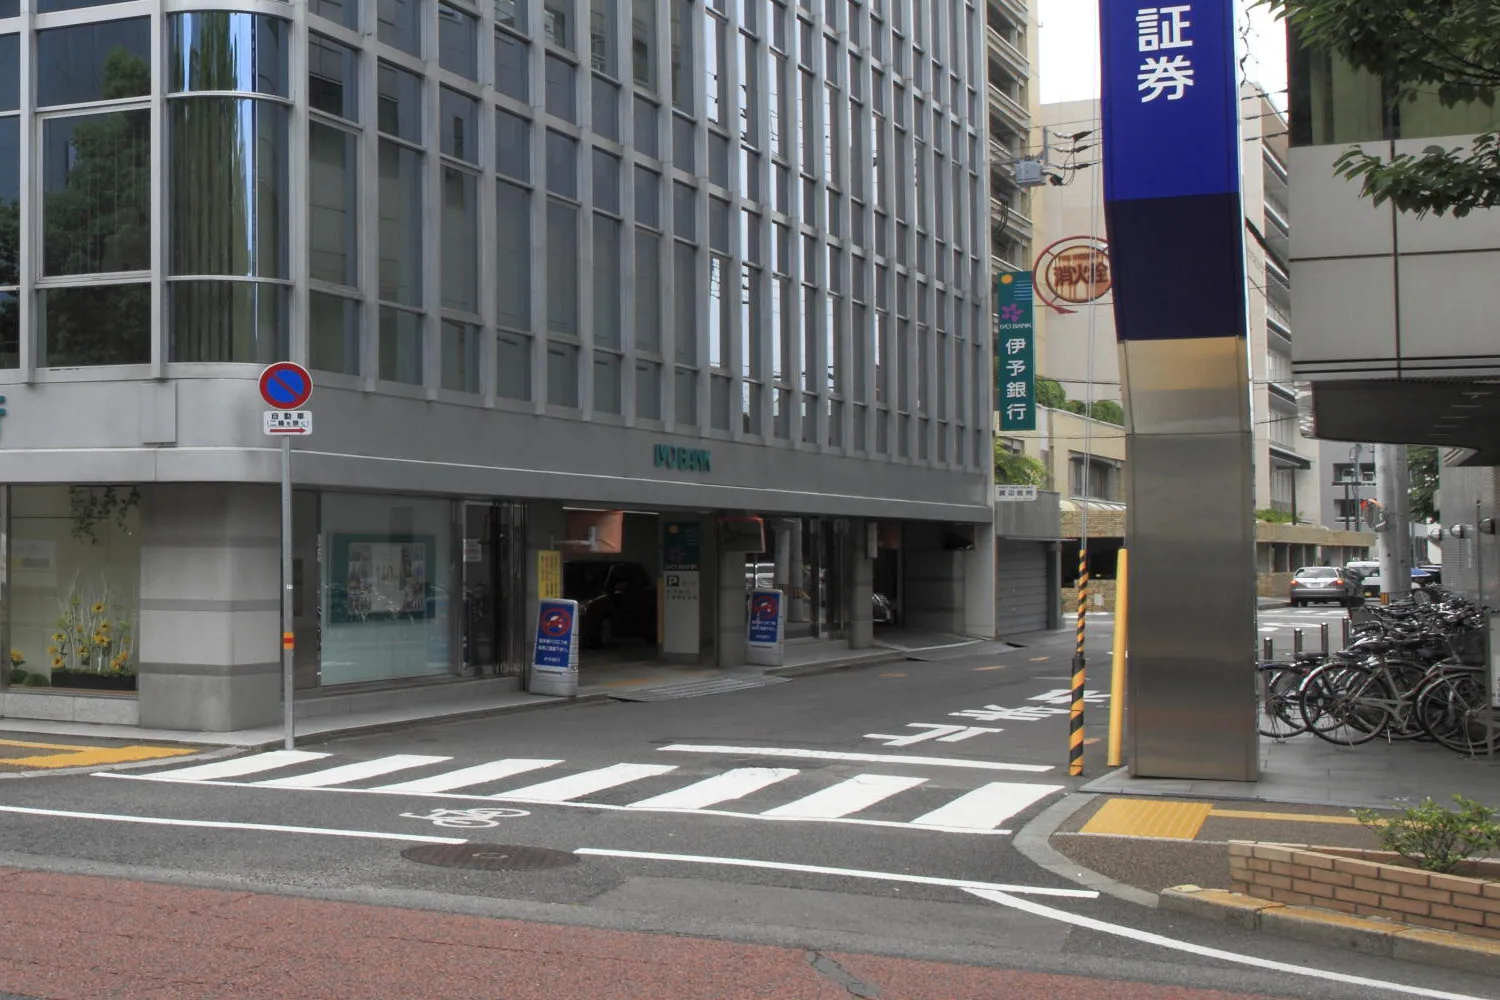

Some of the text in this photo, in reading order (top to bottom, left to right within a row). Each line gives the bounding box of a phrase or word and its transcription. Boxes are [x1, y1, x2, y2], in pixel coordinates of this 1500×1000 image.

[1054, 263, 1109, 286] 消火栓
[1005, 338, 1027, 421] 伊予銀行
[654, 444, 711, 472] IYO BANK
